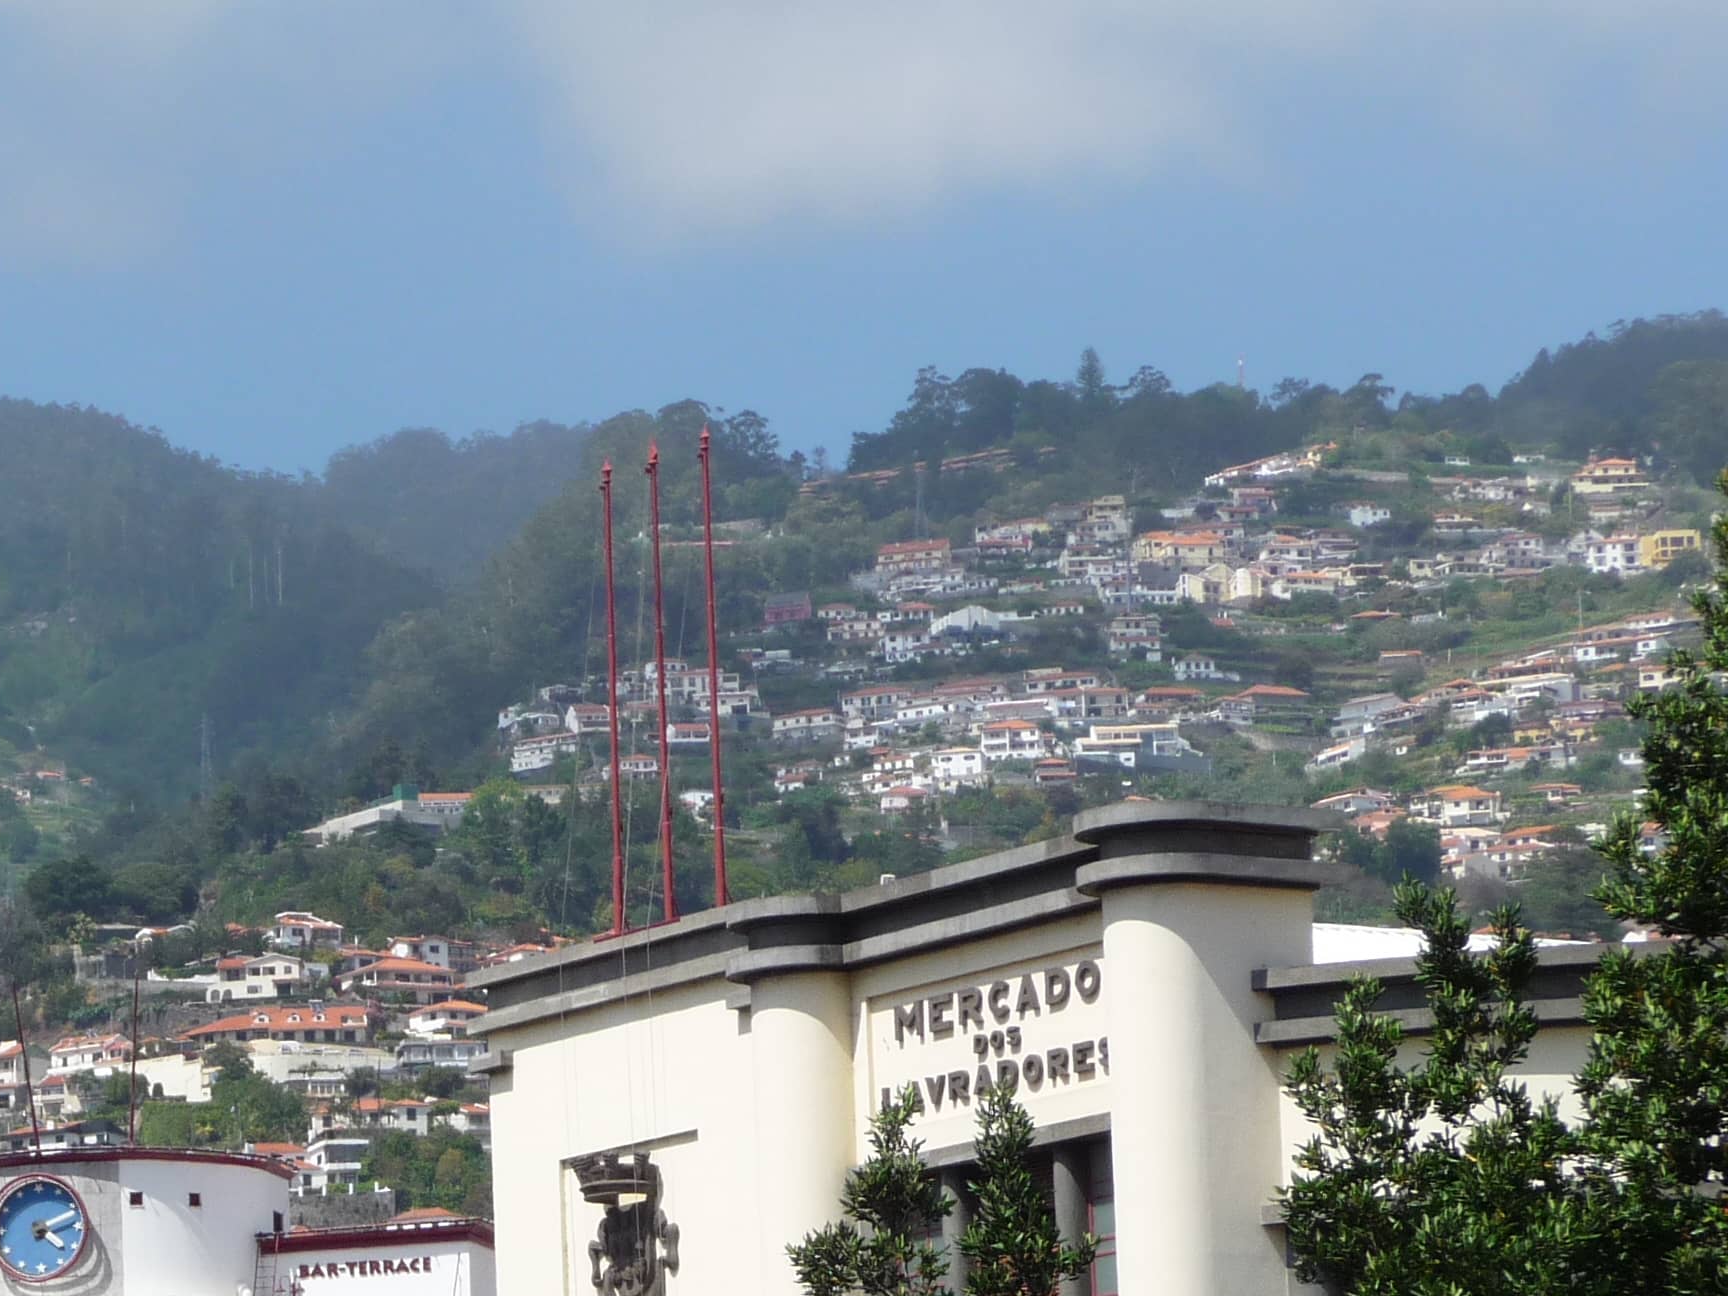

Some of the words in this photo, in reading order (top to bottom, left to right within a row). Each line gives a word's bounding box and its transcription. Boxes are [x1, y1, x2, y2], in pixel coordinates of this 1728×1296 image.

[894, 960, 1101, 1049] MERCADO
[973, 1026, 1022, 1061] DOS
[299, 1256, 432, 1279] BAR-TERRACE
